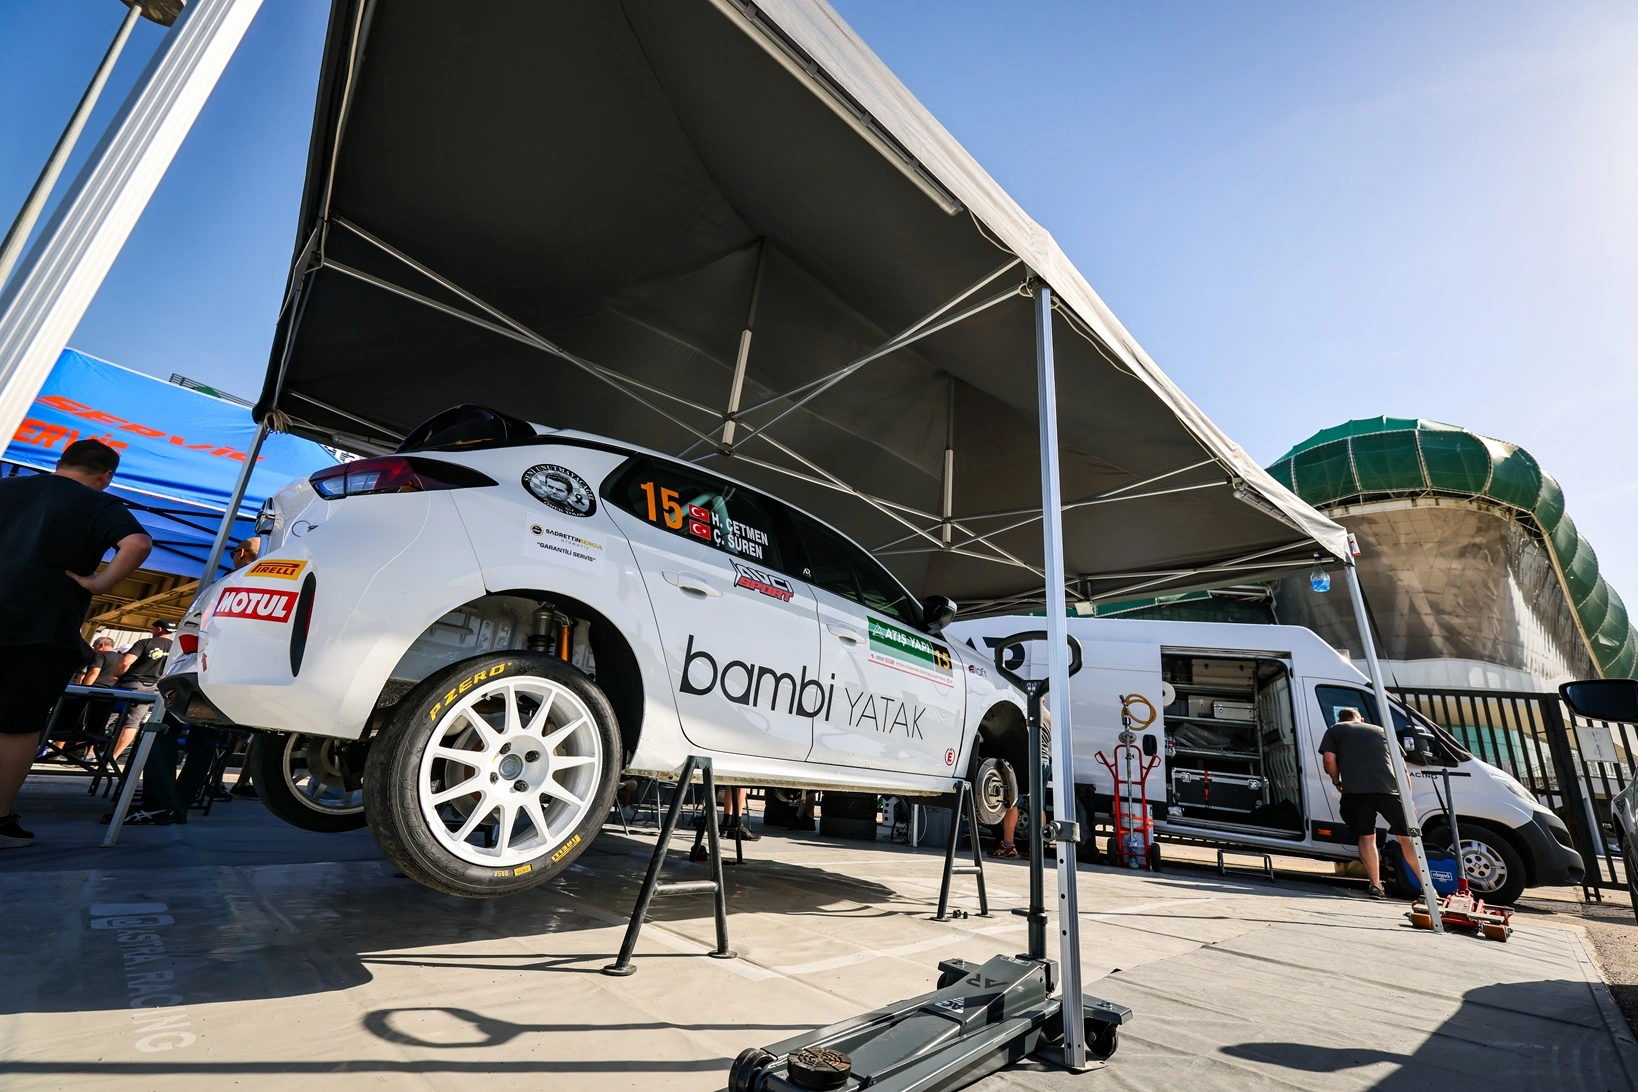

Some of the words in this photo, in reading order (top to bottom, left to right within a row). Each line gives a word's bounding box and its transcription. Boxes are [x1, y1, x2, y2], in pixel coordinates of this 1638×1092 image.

[640, 481, 683, 530] 15
[711, 511, 723, 528] H.
[725, 520, 769, 546] ÇETMEN
[713, 528, 725, 547] Ç.
[727, 533, 763, 560] SÜREN
[250, 562, 301, 576] PIRELLI
[736, 575, 795, 602] SPORT
[215, 591, 289, 618] MOTUL
[885, 627, 908, 647] ATIŞ
[908, 636, 931, 654] YAPI
[934, 649, 951, 670] 15
[679, 634, 835, 722] bambi
[844, 687, 927, 740] YATAK
[125, 970, 197, 1053] RACING
